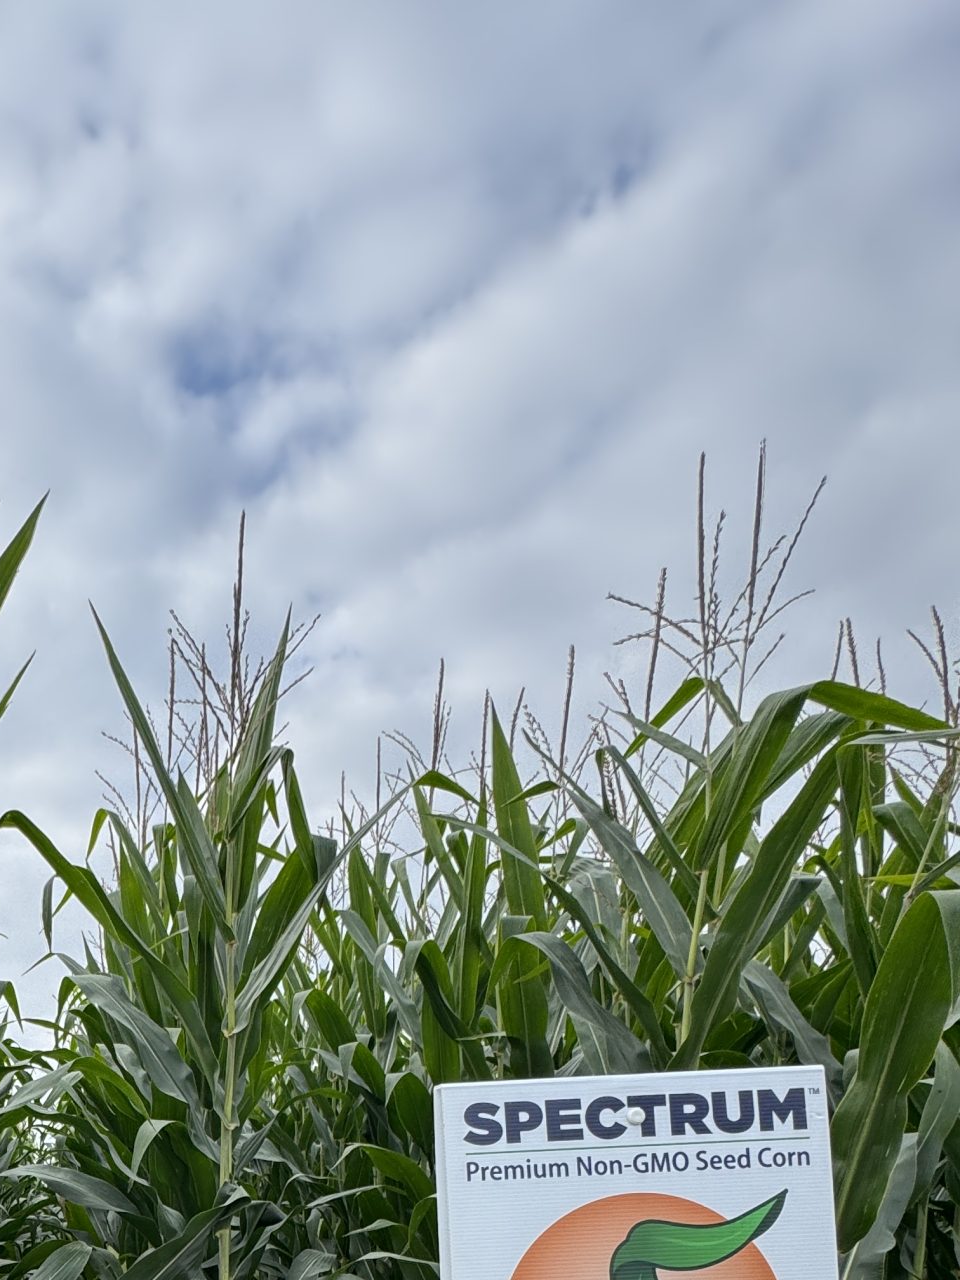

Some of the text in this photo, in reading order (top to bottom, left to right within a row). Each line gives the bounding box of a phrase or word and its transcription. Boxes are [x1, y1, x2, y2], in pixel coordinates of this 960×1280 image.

[463, 1088, 808, 1146] SPECTRUM
[466, 1147, 810, 1182] Premium Non-GMO Seed Corn
